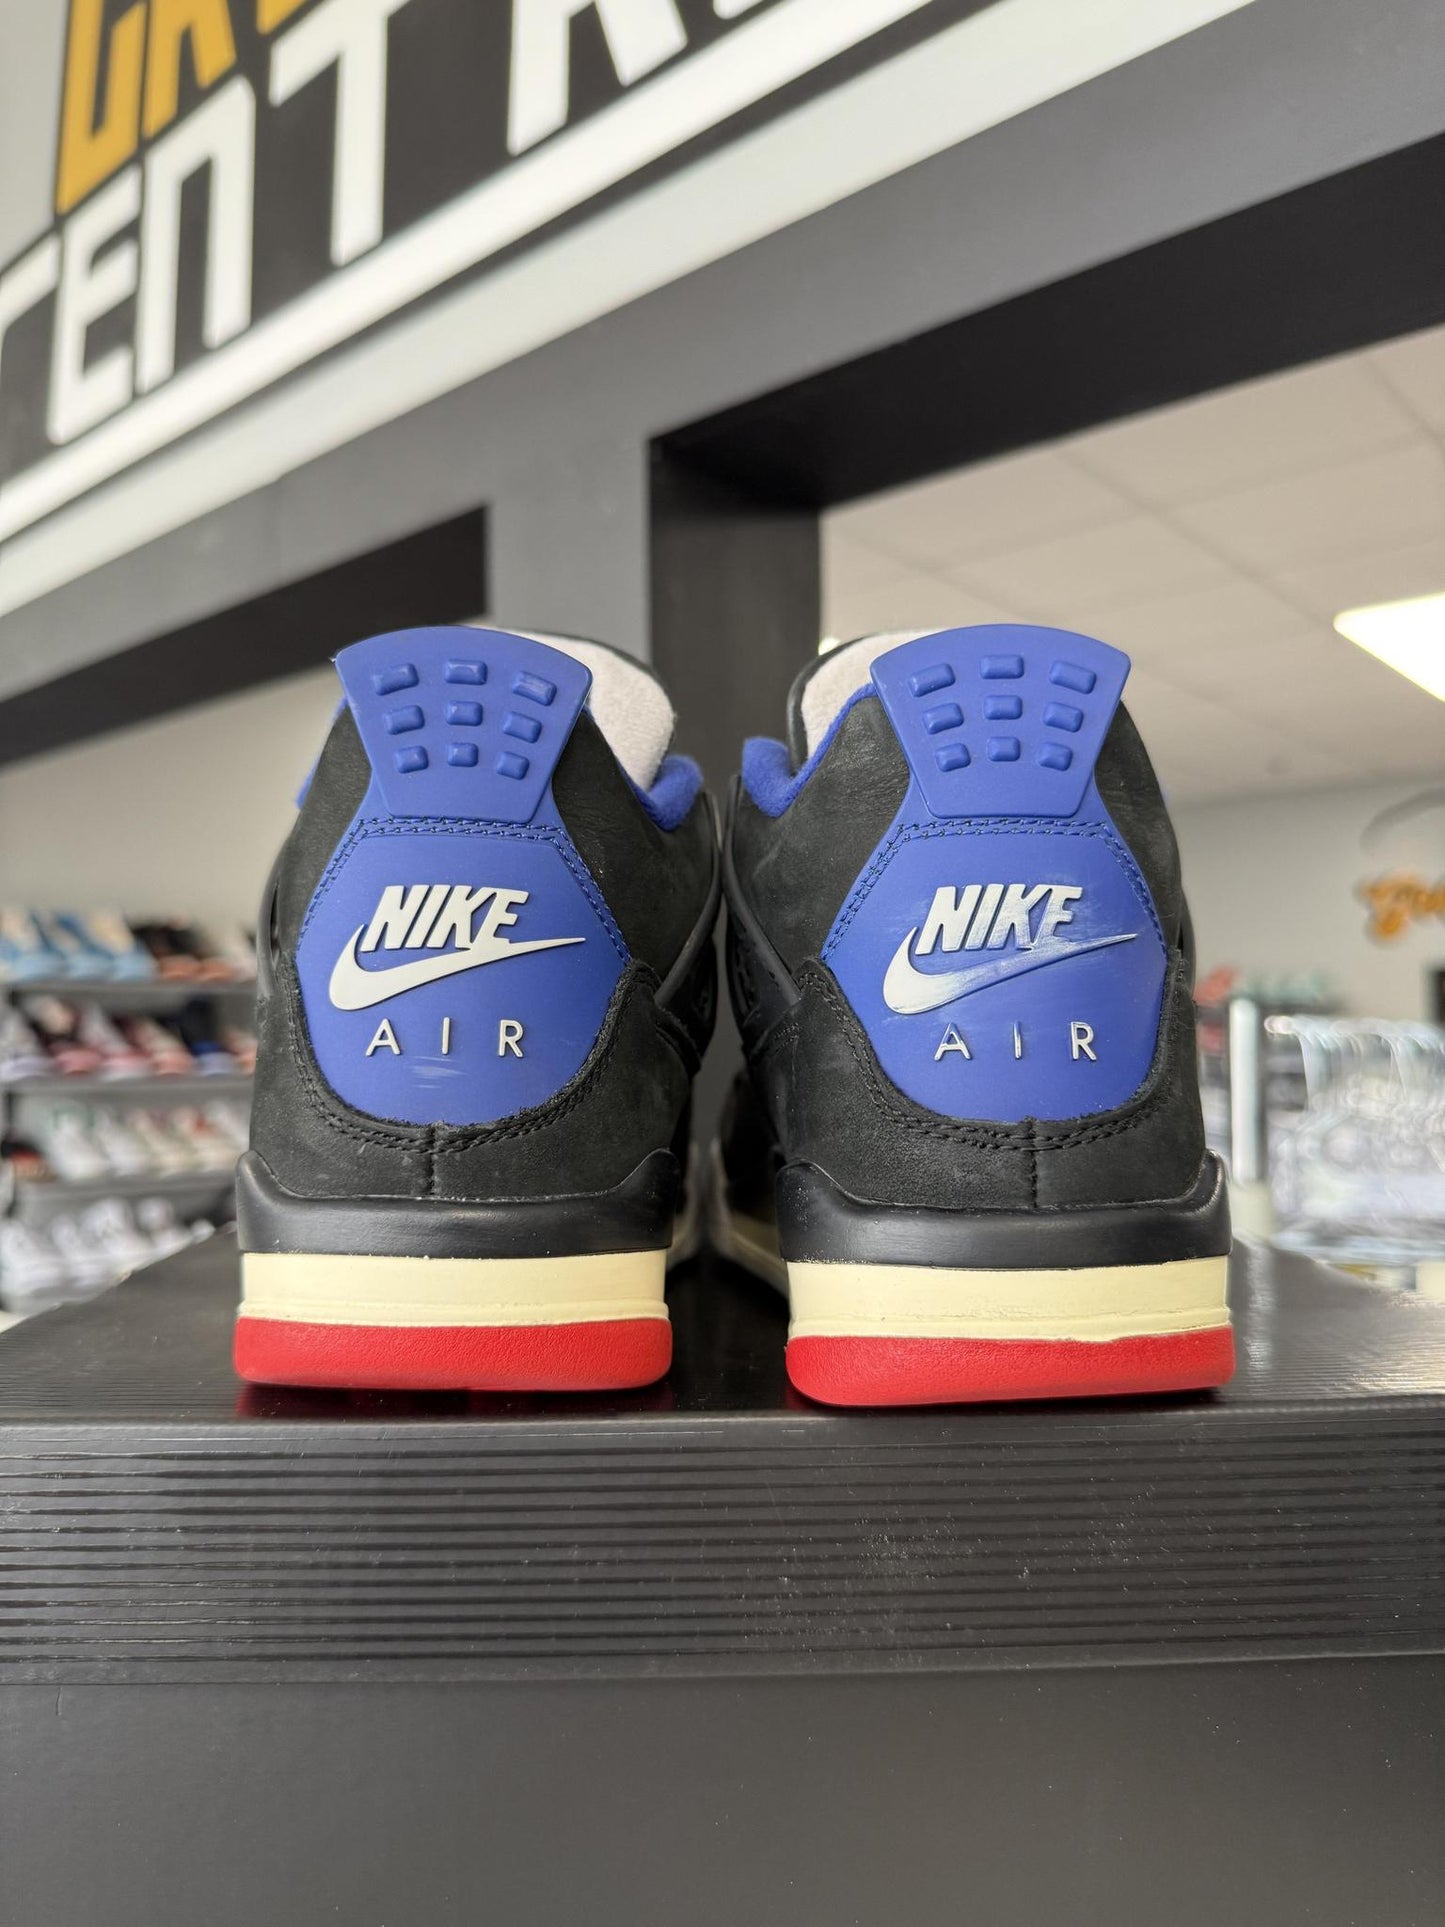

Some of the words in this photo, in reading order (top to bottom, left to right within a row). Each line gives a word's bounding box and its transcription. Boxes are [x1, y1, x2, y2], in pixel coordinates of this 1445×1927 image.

[360, 884, 529, 953] NIKE
[914, 883, 1083, 956] NIKE
[365, 1016, 525, 1058] AIR
[933, 1021, 1097, 1062] AIR
